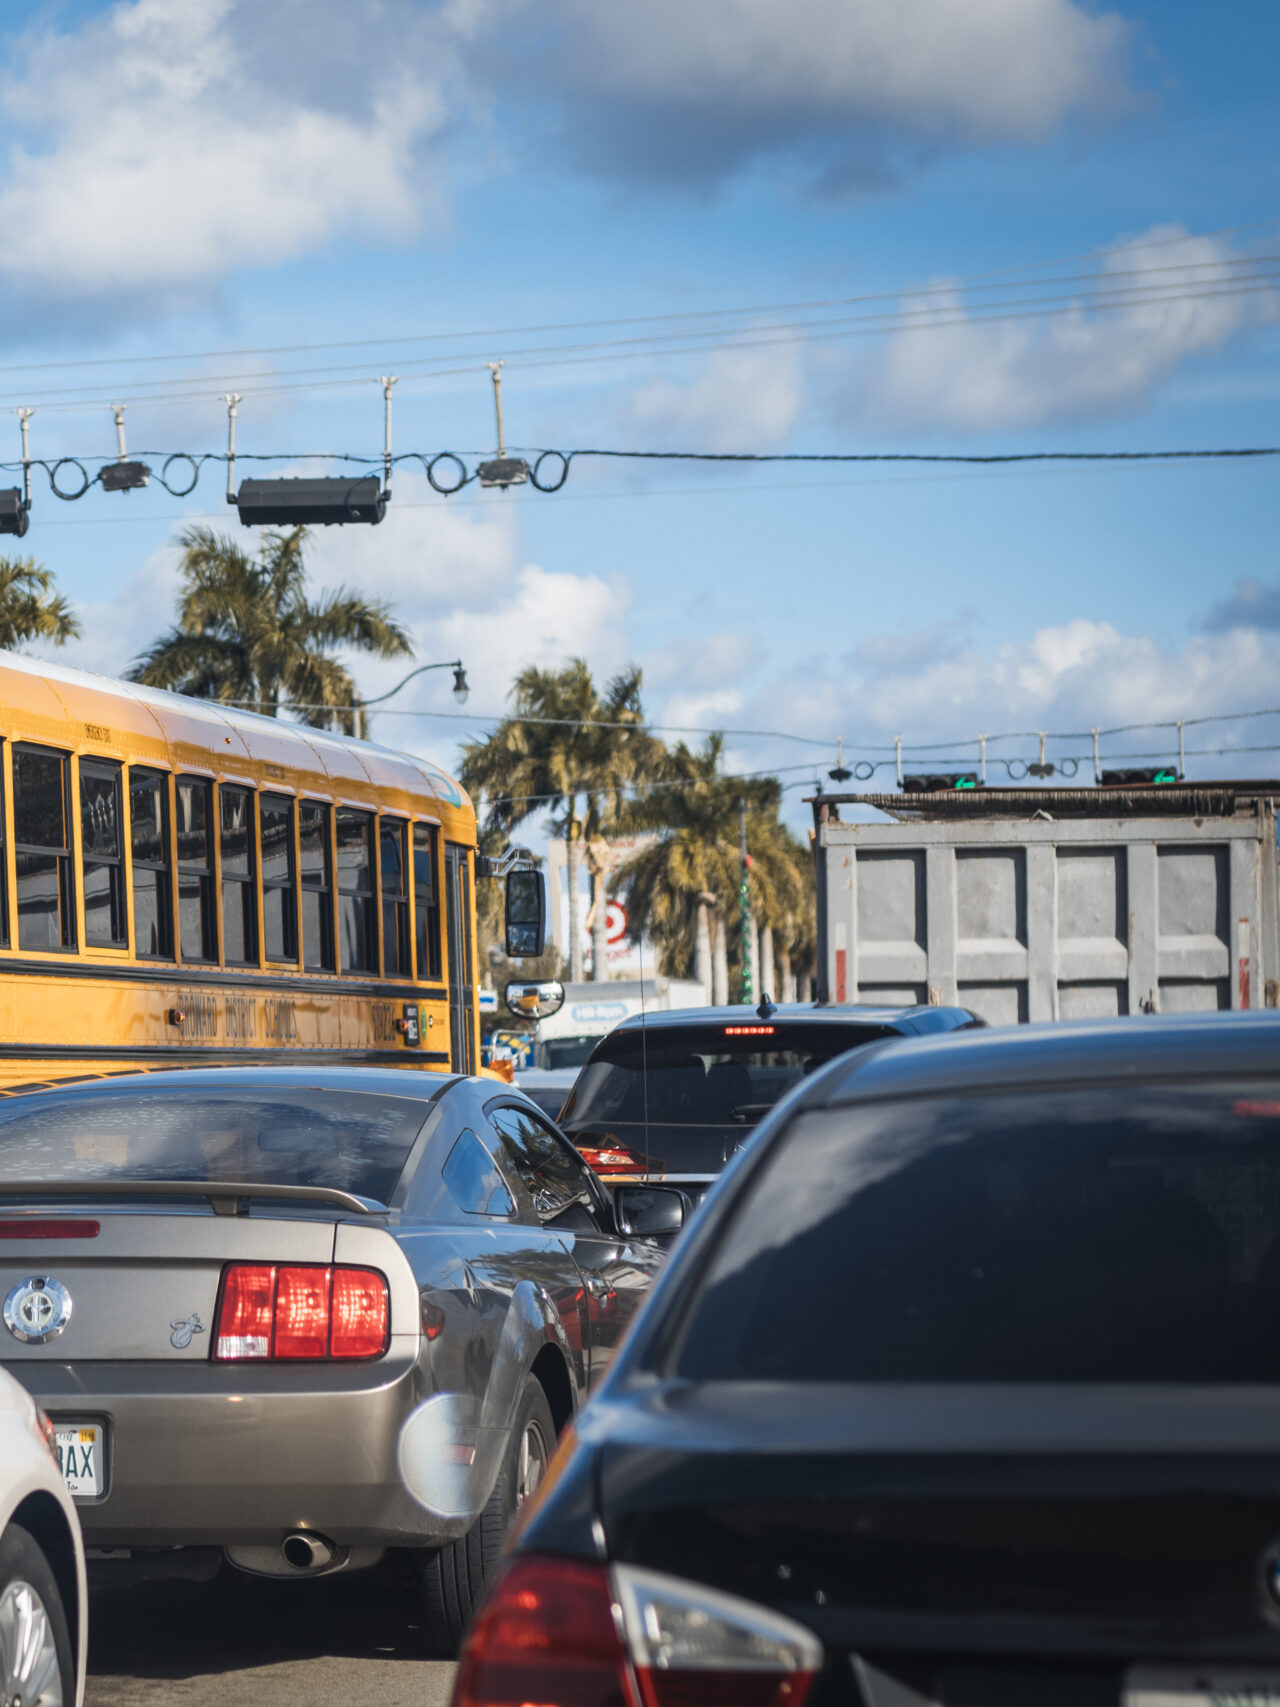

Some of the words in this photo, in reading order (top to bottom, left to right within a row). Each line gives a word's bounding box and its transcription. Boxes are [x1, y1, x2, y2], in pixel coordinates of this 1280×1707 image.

[179, 994, 218, 1037] BROWARD
[225, 997, 257, 1038] DISTRICT
[264, 999, 297, 1039] SCHOOLS
